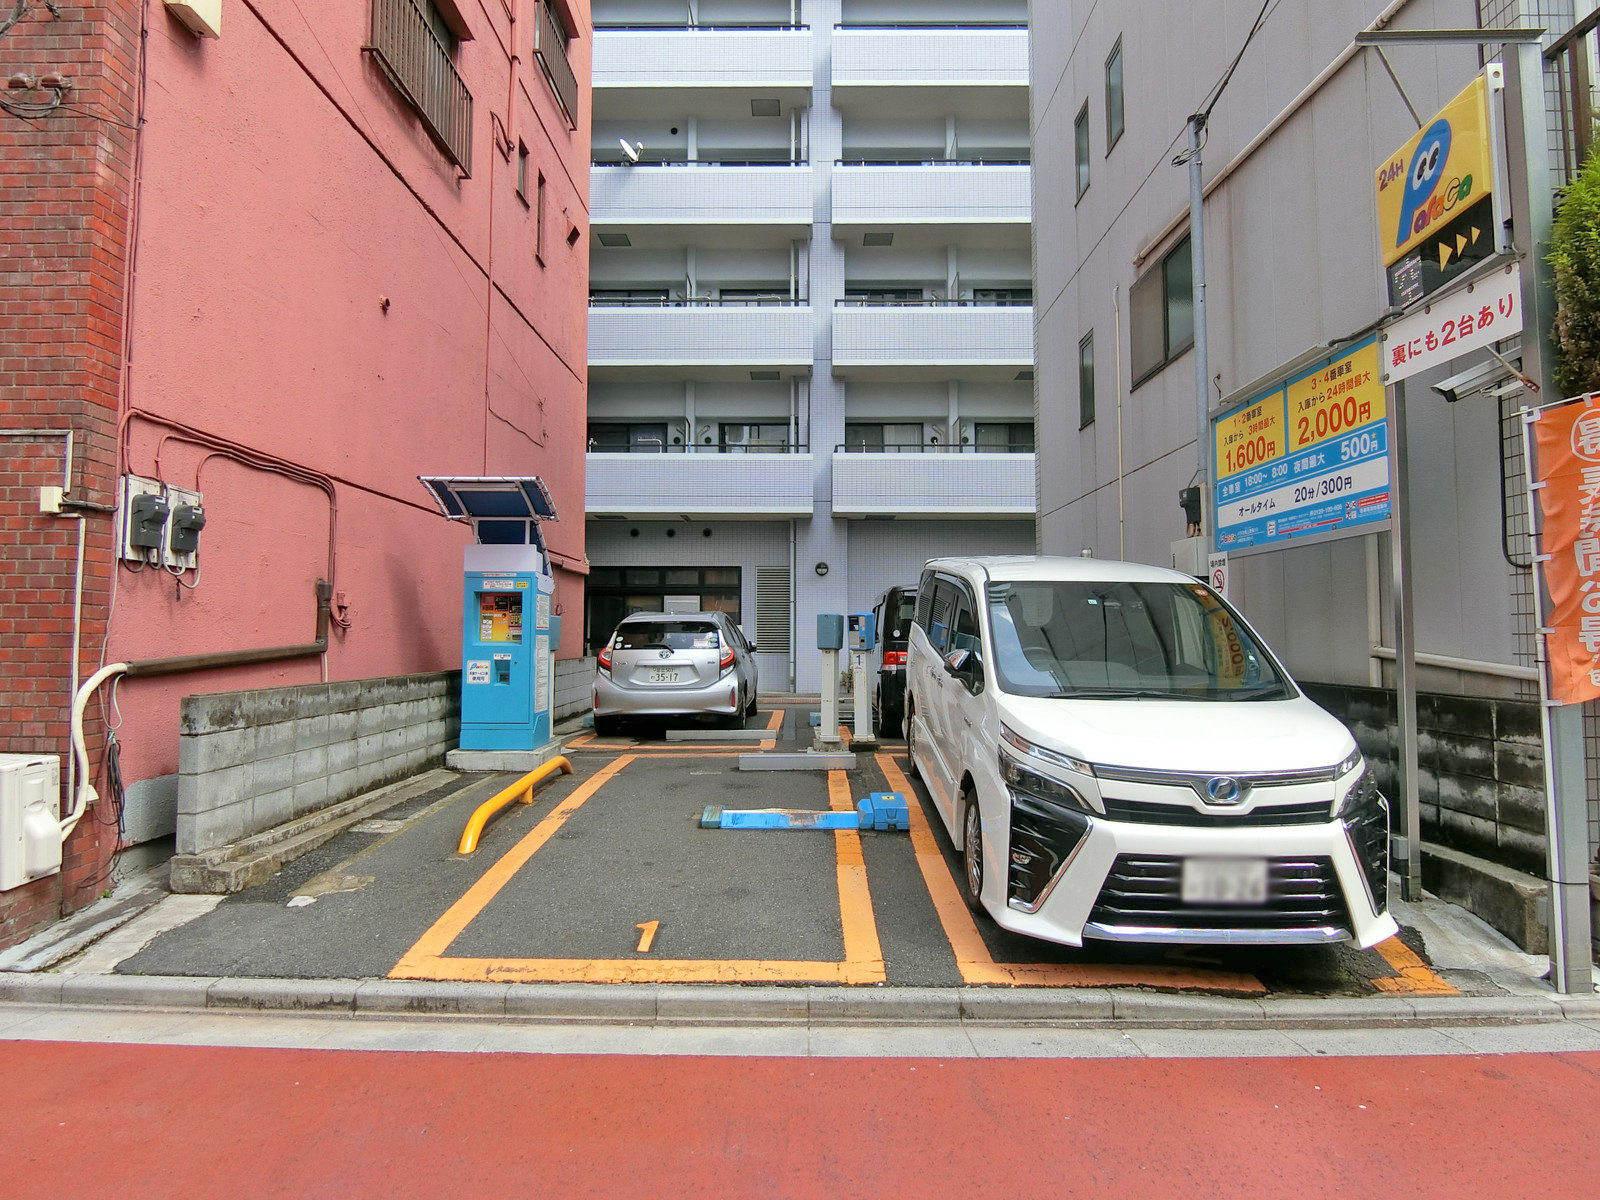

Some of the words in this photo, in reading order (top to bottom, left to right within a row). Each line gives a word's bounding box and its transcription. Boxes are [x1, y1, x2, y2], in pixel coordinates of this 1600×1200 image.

[1378, 157, 1404, 193] 24H
[1391, 292, 1515, 369] 裏にも2台あり
[1297, 396, 1371, 446] 2,000円
[1226, 436, 1276, 473] 1,600円
[1340, 434, 1379, 461] 500円
[1238, 498, 1276, 517] オールタイム
[856, 654, 861, 666] 1
[655, 673, 679, 682] 35-17
[635, 920, 660, 953] 1
